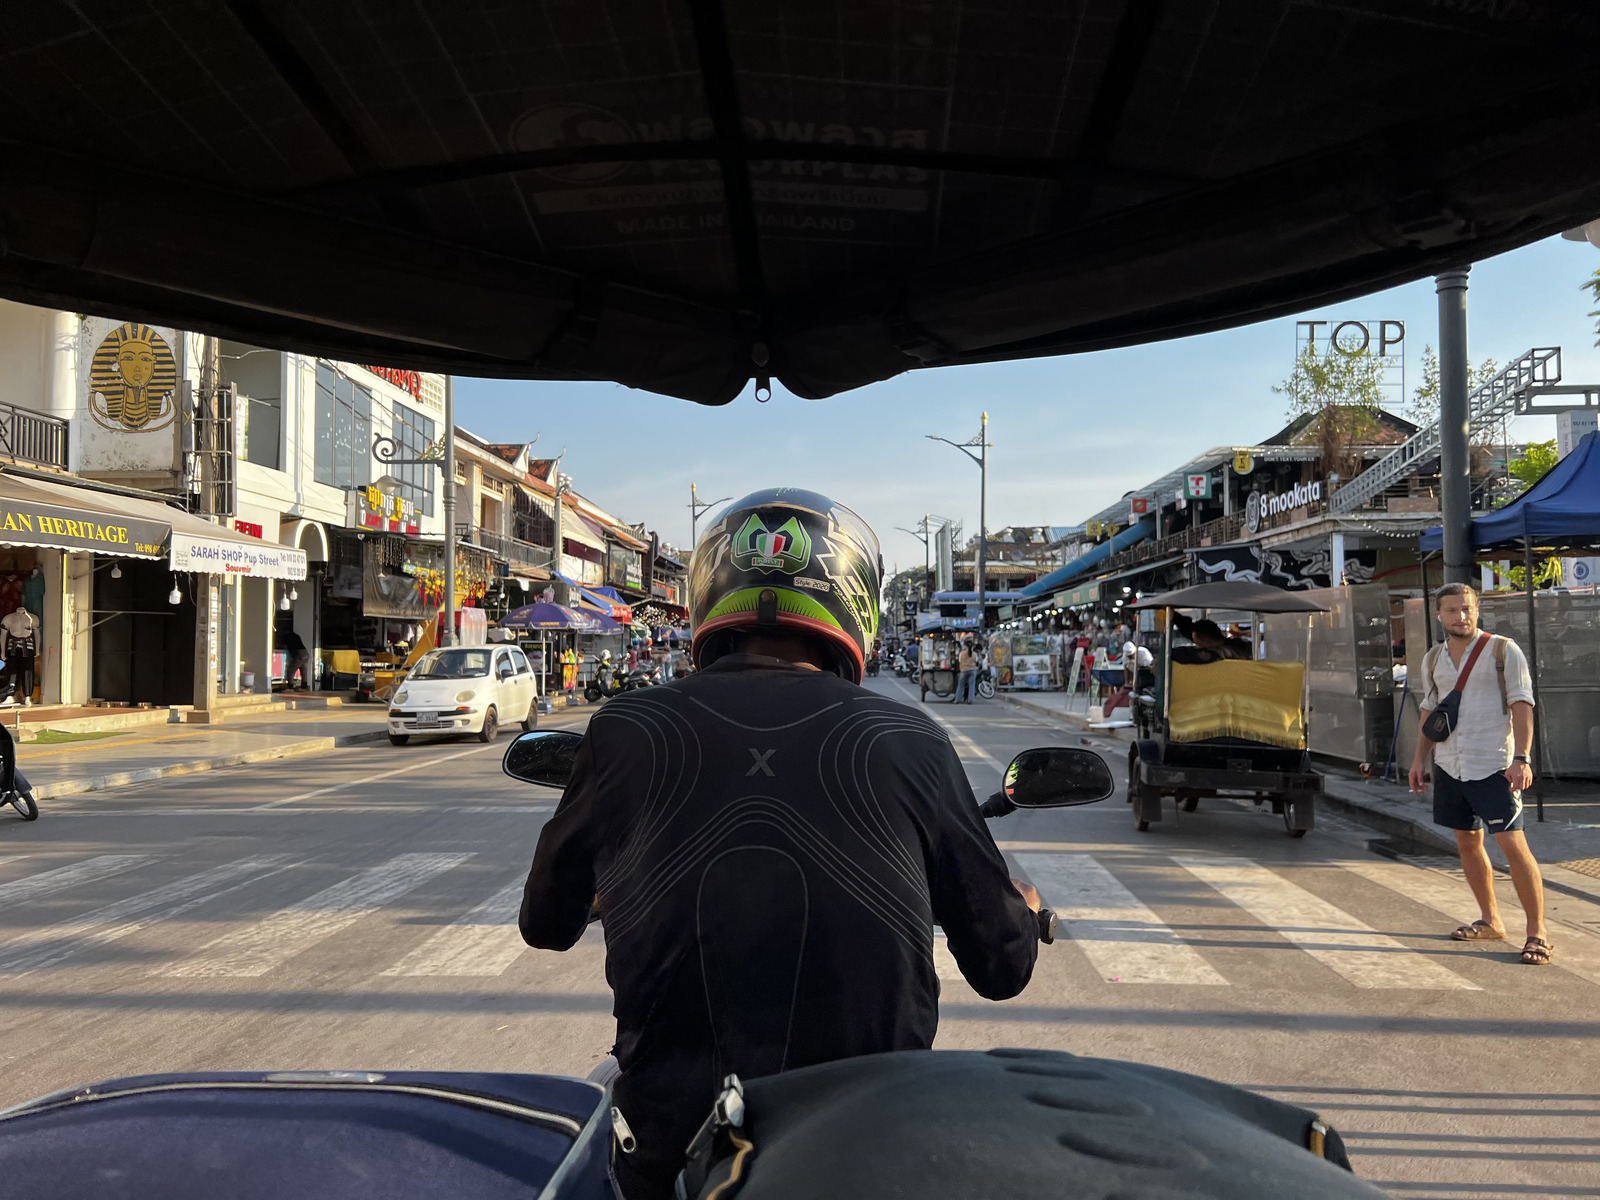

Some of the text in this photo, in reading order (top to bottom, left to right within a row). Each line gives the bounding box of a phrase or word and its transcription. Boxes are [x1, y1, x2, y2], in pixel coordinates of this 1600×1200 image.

[617, 213, 856, 233] MADE IN AILAND
[1296, 320, 1405, 357] TOP
[1260, 480, 1321, 518] 8 mookata
[36, 515, 129, 544] HERITAGE
[191, 545, 219, 560] SARAH
[221, 549, 243, 563] SHOP
[244, 552, 258, 566] Pup
[259, 555, 279, 567] Street
[225, 563, 252, 573] Souvenir
[795, 579, 829, 591] Style 2020
[745, 748, 777, 777] X
